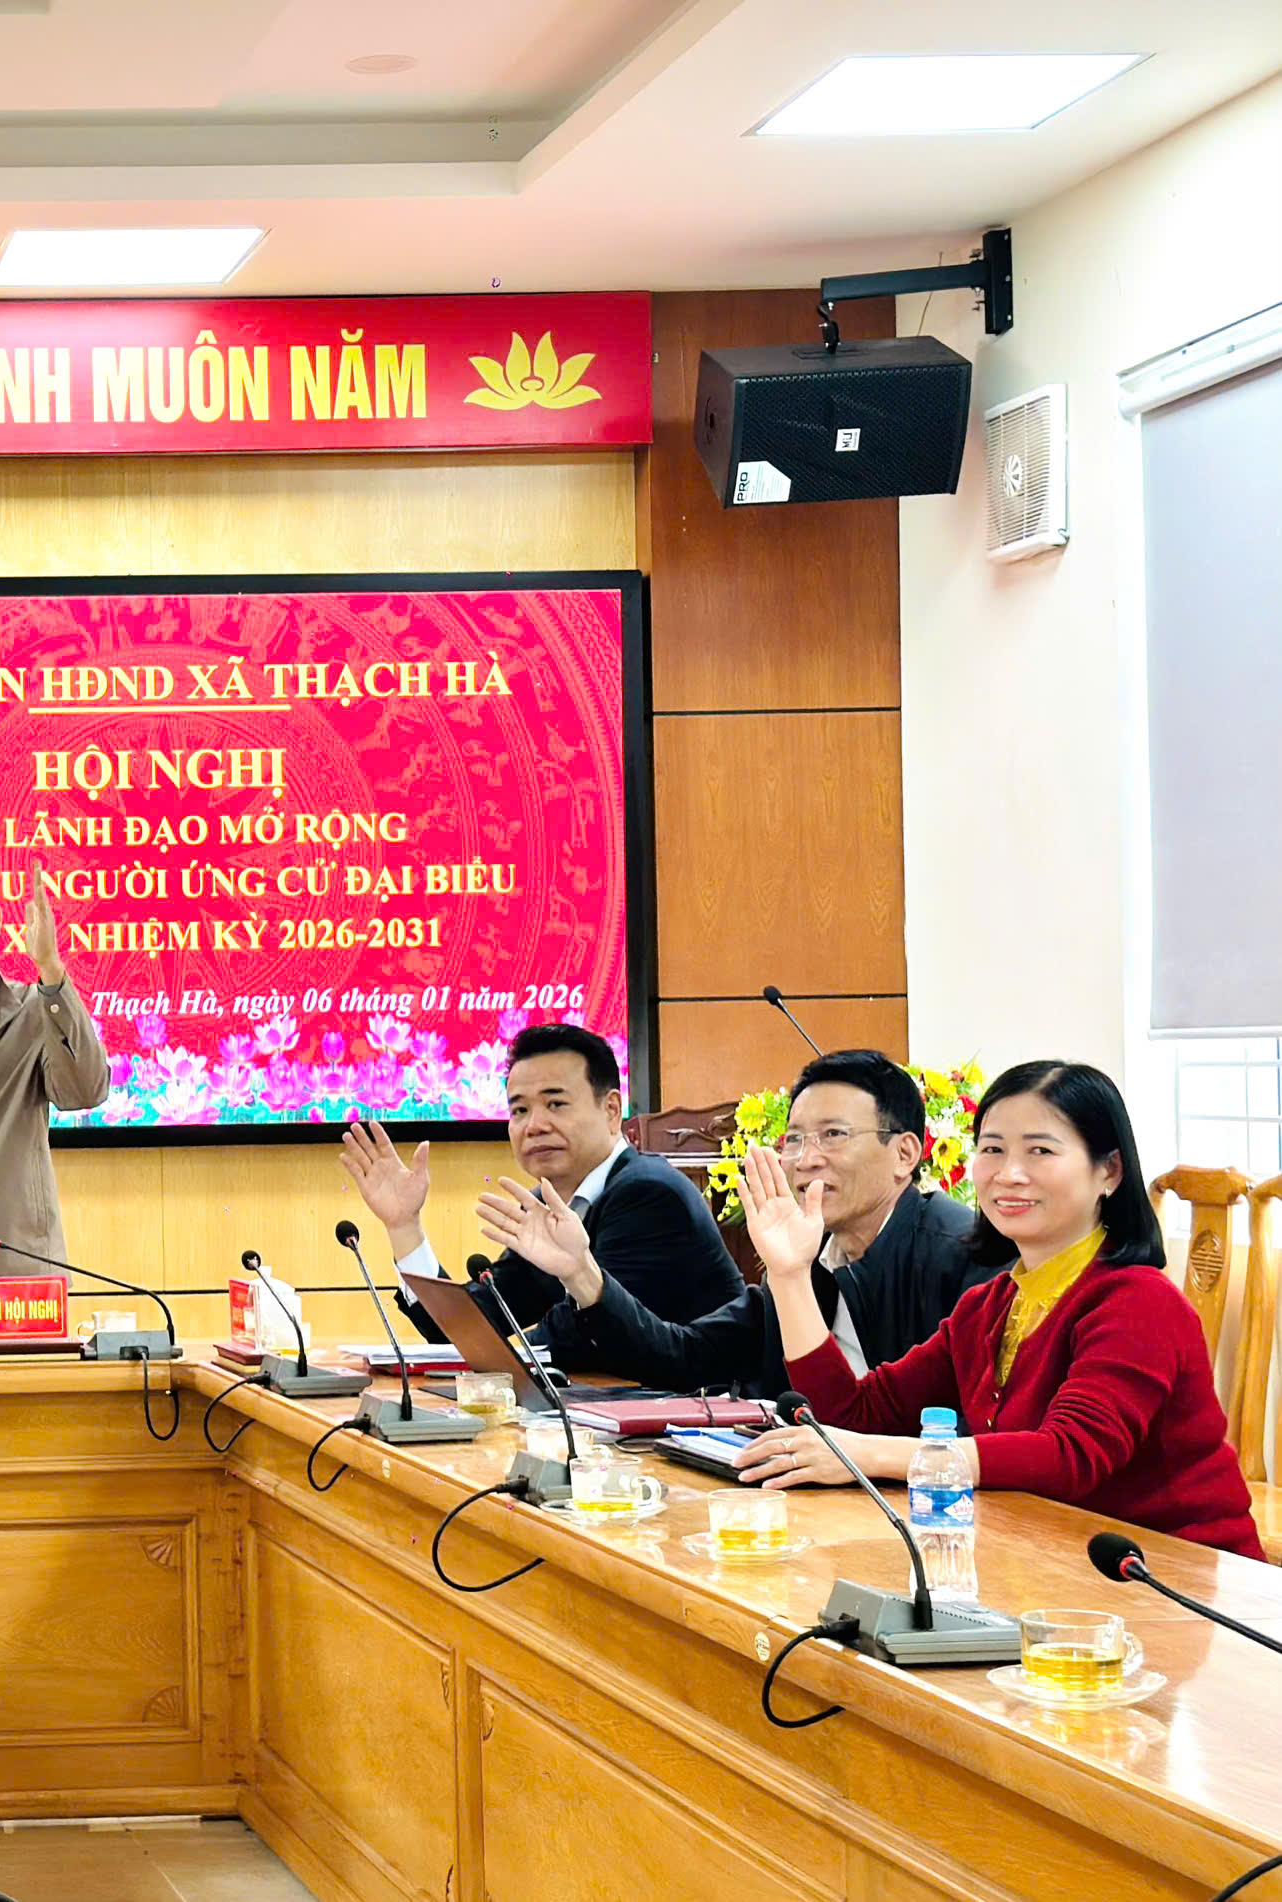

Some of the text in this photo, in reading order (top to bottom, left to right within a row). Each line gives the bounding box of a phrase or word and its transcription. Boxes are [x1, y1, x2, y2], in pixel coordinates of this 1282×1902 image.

[92, 330, 269, 423] MUÔN
[291, 328, 427, 420] NĂM
[737, 472, 750, 501] PRO
[40, 665, 175, 701] HĐND
[187, 655, 254, 701] XÃ
[263, 662, 432, 708] THẠCH
[445, 651, 512, 697] HÀ
[32, 744, 287, 801] HỘI NGHỊ
[5, 811, 112, 848] LÃNH
[123, 815, 208, 854] ĐẠO
[219, 806, 285, 845] MỞ
[295, 808, 407, 851] RỘNG
[38, 860, 168, 900] NGƯỜI
[181, 860, 267, 899] ỨNG
[277, 857, 337, 897] CỬ
[344, 865, 414, 904] ĐẠI
[425, 855, 516, 895] BIỂU
[68, 917, 200, 959] NHIỆM
[213, 912, 268, 951] KỲ
[278, 917, 443, 949] 2026-2031
[92, 983, 585, 1022] Thạch Hà, ngày 06 tháng 01 năm 2026
[4, 1296, 26, 1325] HỘI
[28, 1299, 58, 1323] NGHỊ
